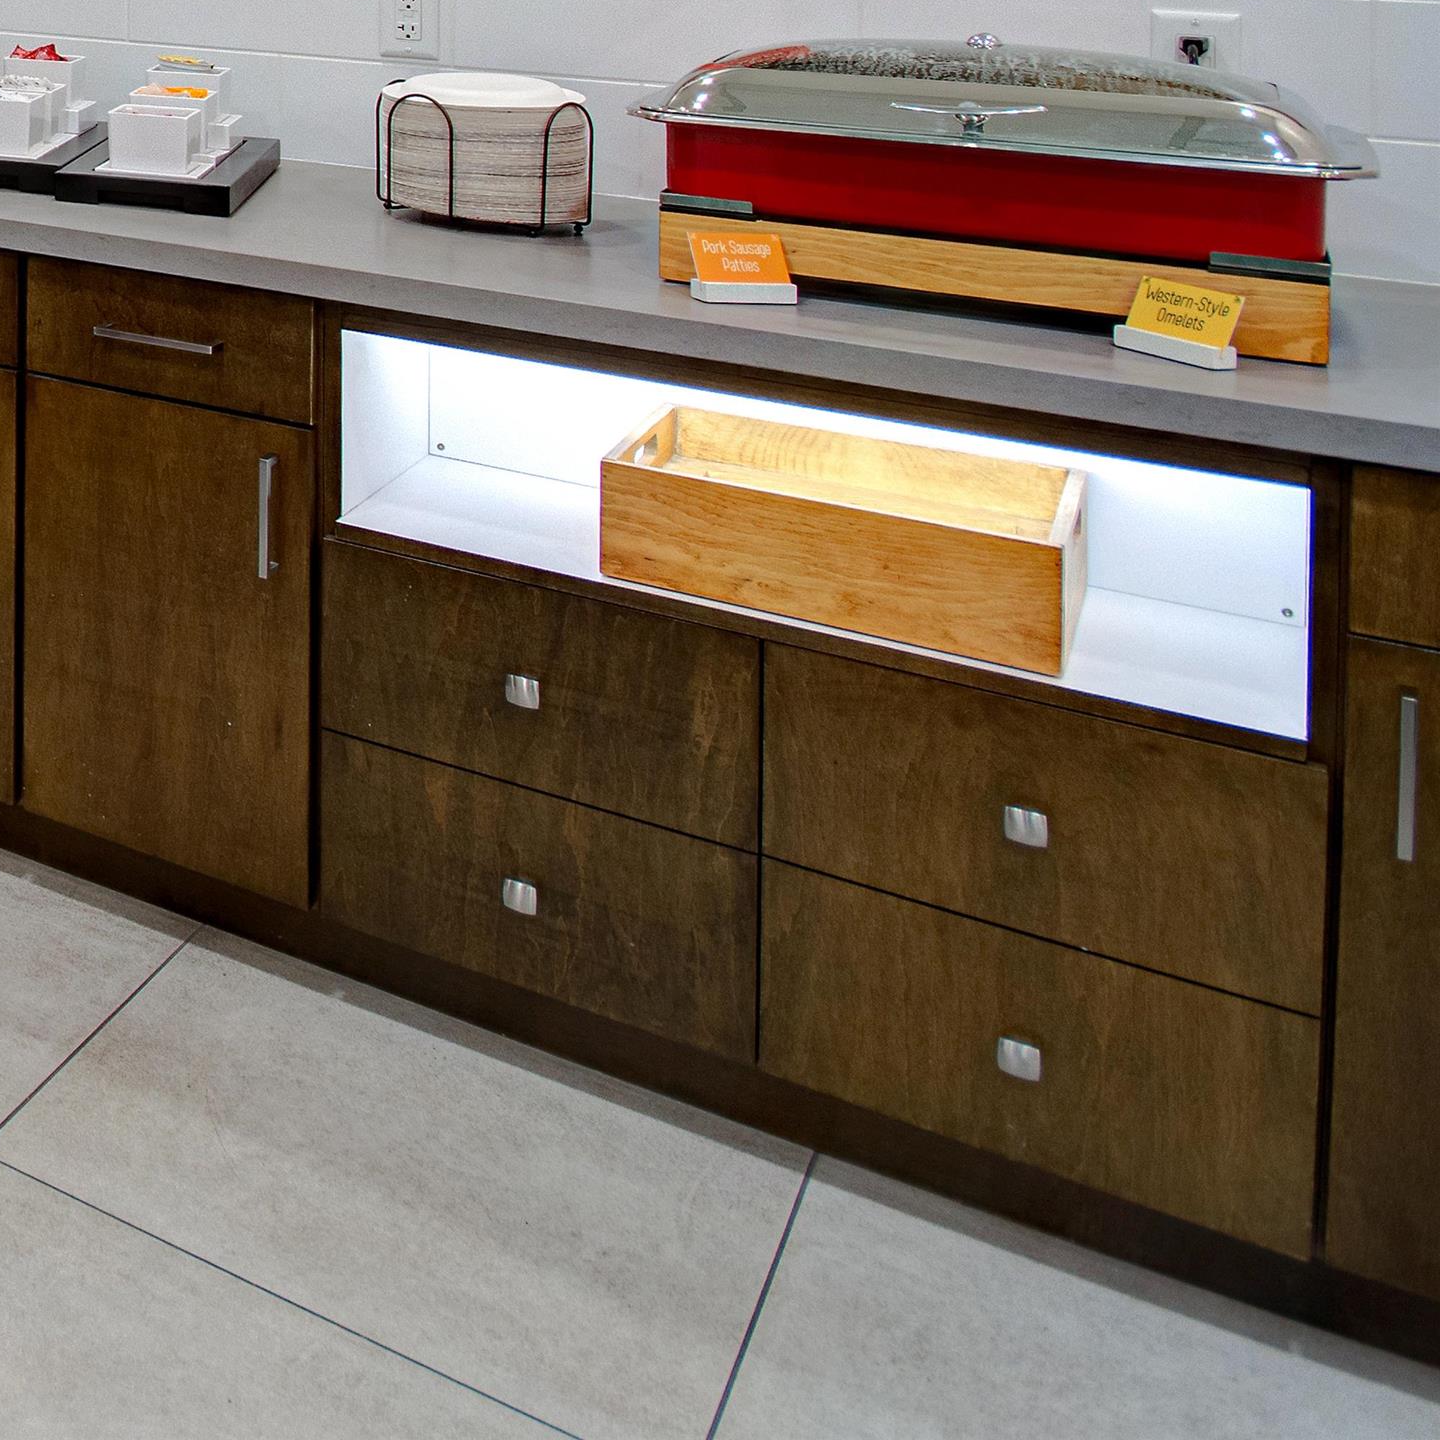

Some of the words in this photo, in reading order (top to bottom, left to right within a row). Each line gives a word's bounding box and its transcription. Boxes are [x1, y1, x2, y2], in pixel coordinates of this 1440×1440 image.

[702, 240, 727, 254] Pork
[729, 240, 772, 258] Sausage
[722, 257, 761, 273] Patties
[1146, 285, 1230, 318] Western-Style
[1157, 307, 1206, 332] Omelets
